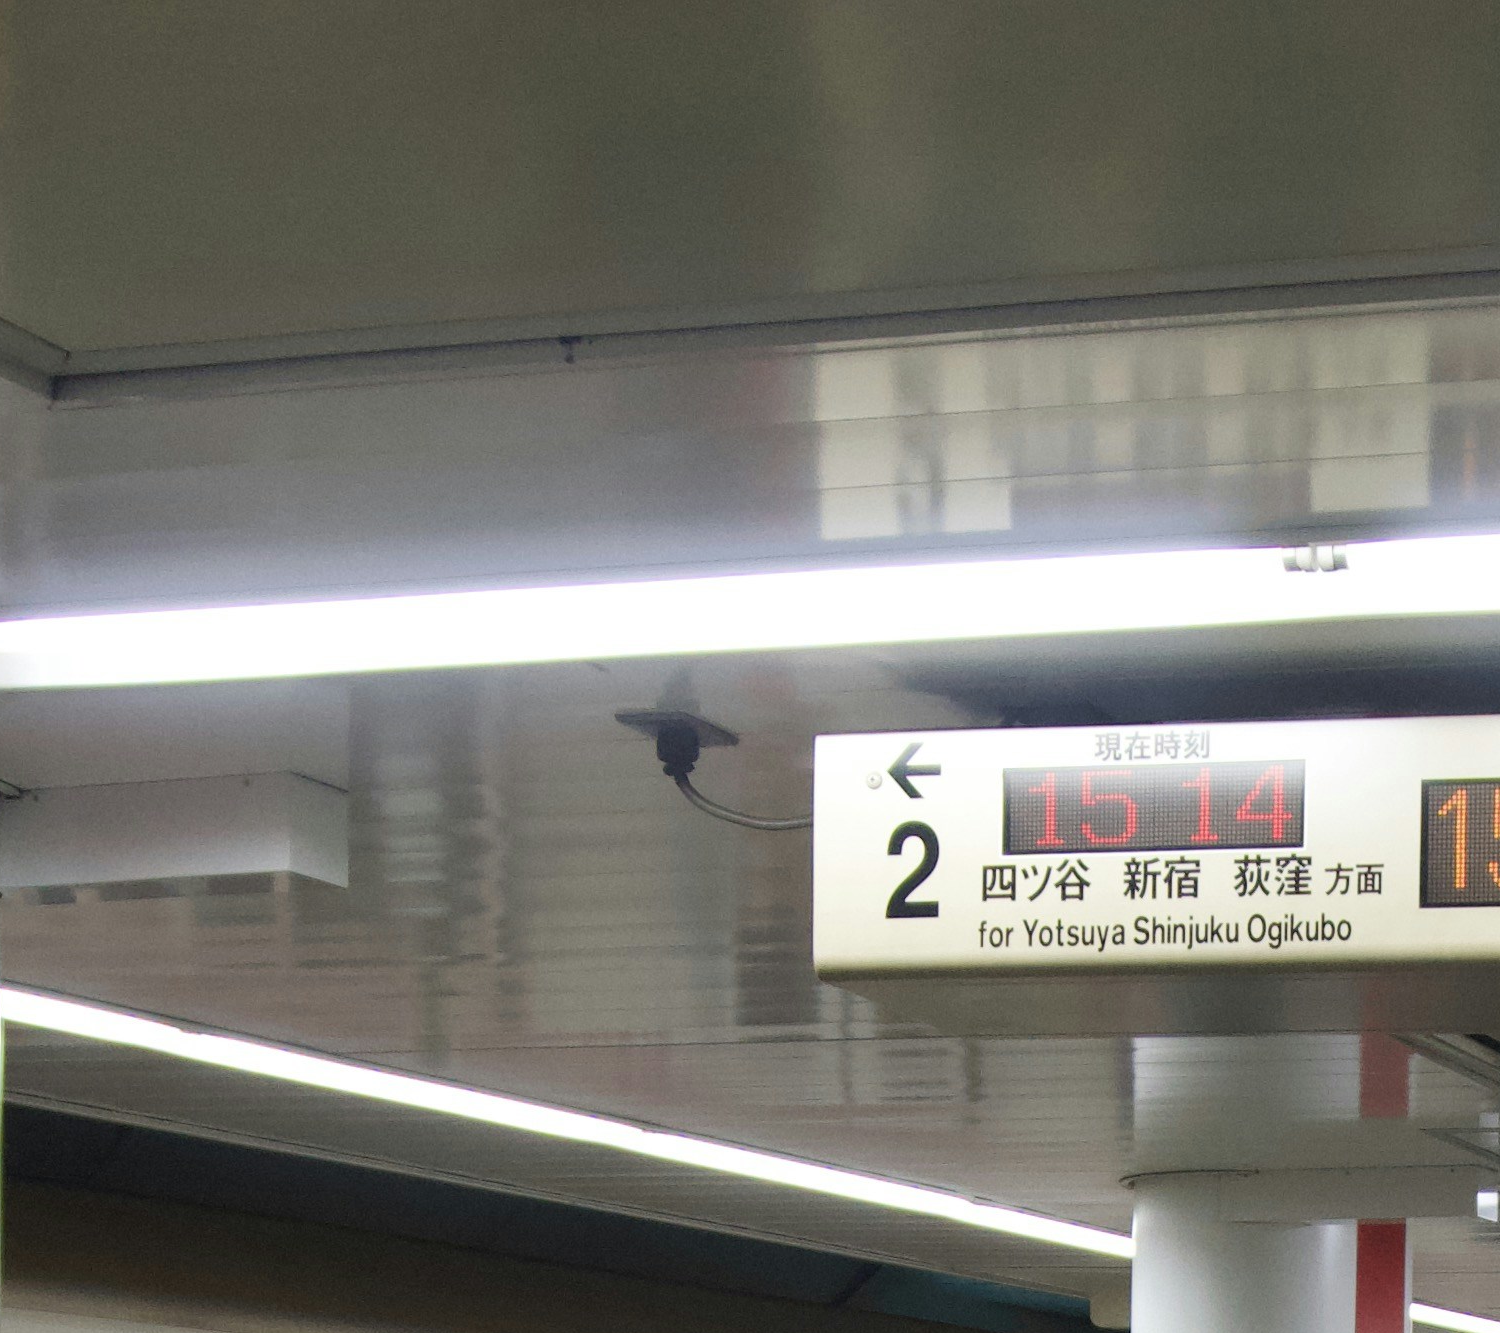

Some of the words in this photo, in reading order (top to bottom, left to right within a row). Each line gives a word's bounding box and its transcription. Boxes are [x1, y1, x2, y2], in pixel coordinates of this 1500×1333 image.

[1094, 730, 1211, 761] 現在時刻
[885, 820, 941, 919] 2
[981, 861, 1092, 902] 四ツ谷
[1123, 857, 1200, 901] 新宿
[1234, 853, 1313, 898] 荻窪
[1325, 862, 1384, 895] 方面
[978, 920, 1011, 948] for
[1023, 917, 1127, 952] Yotsuya
[1134, 914, 1241, 950] Shinjuku
[1246, 912, 1352, 948] Ogikubo
